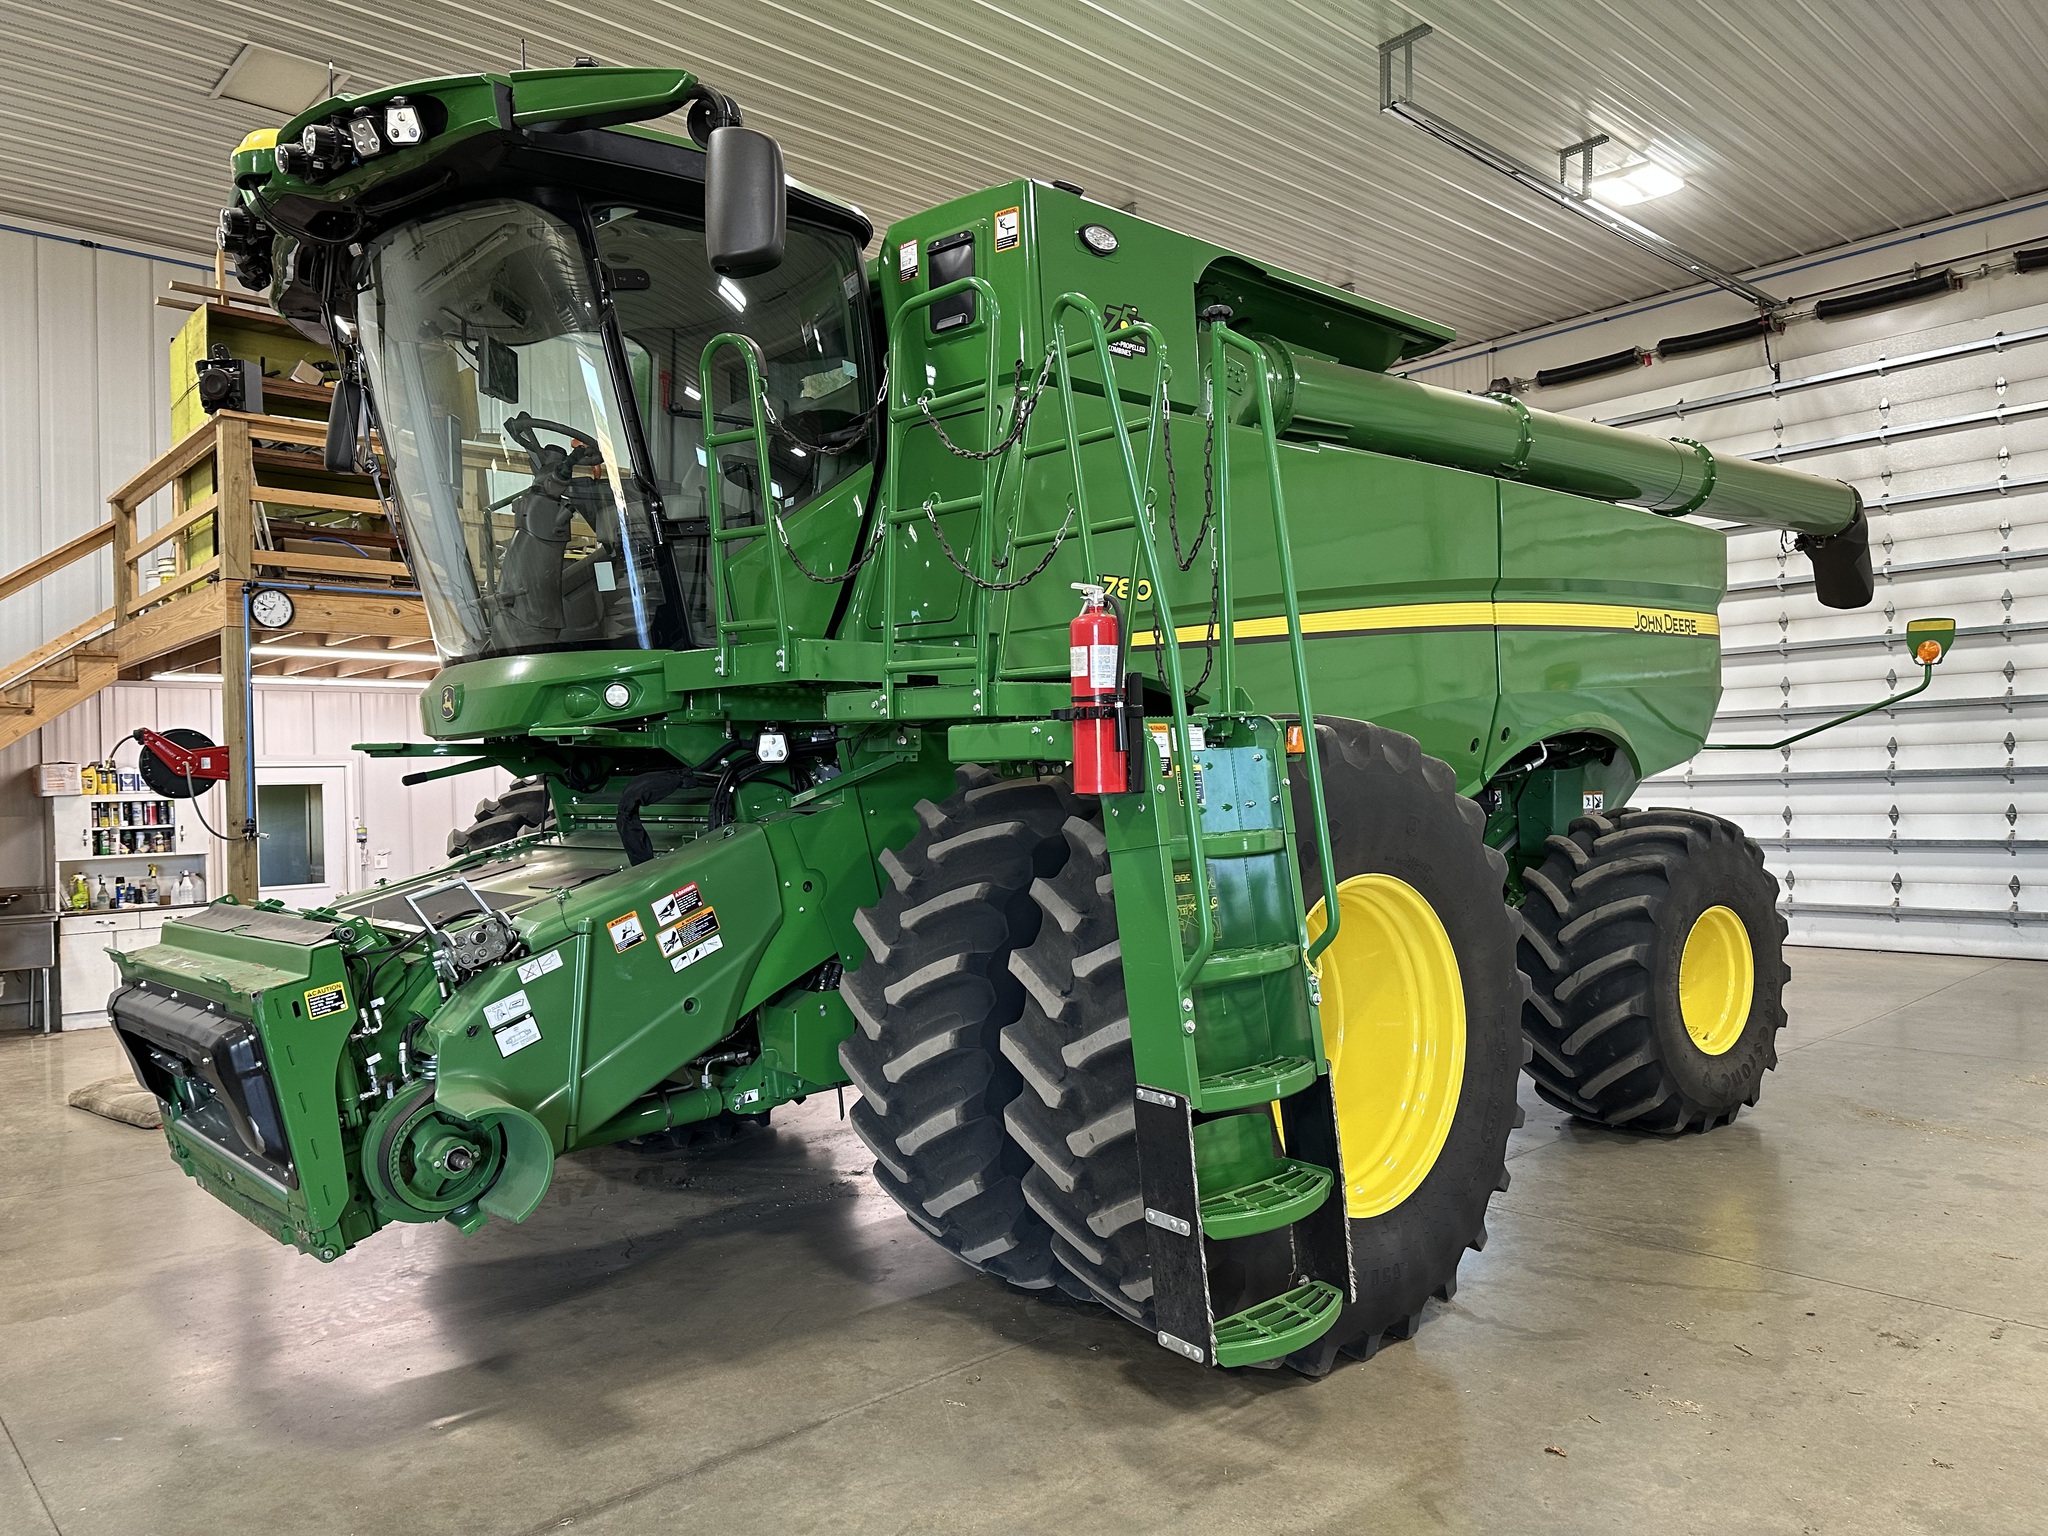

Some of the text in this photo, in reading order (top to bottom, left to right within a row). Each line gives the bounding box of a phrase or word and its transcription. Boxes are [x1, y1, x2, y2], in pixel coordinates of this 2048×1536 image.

[1633, 611, 1698, 634] JOHN DEERE
[312, 983, 342, 996] CAUTION
